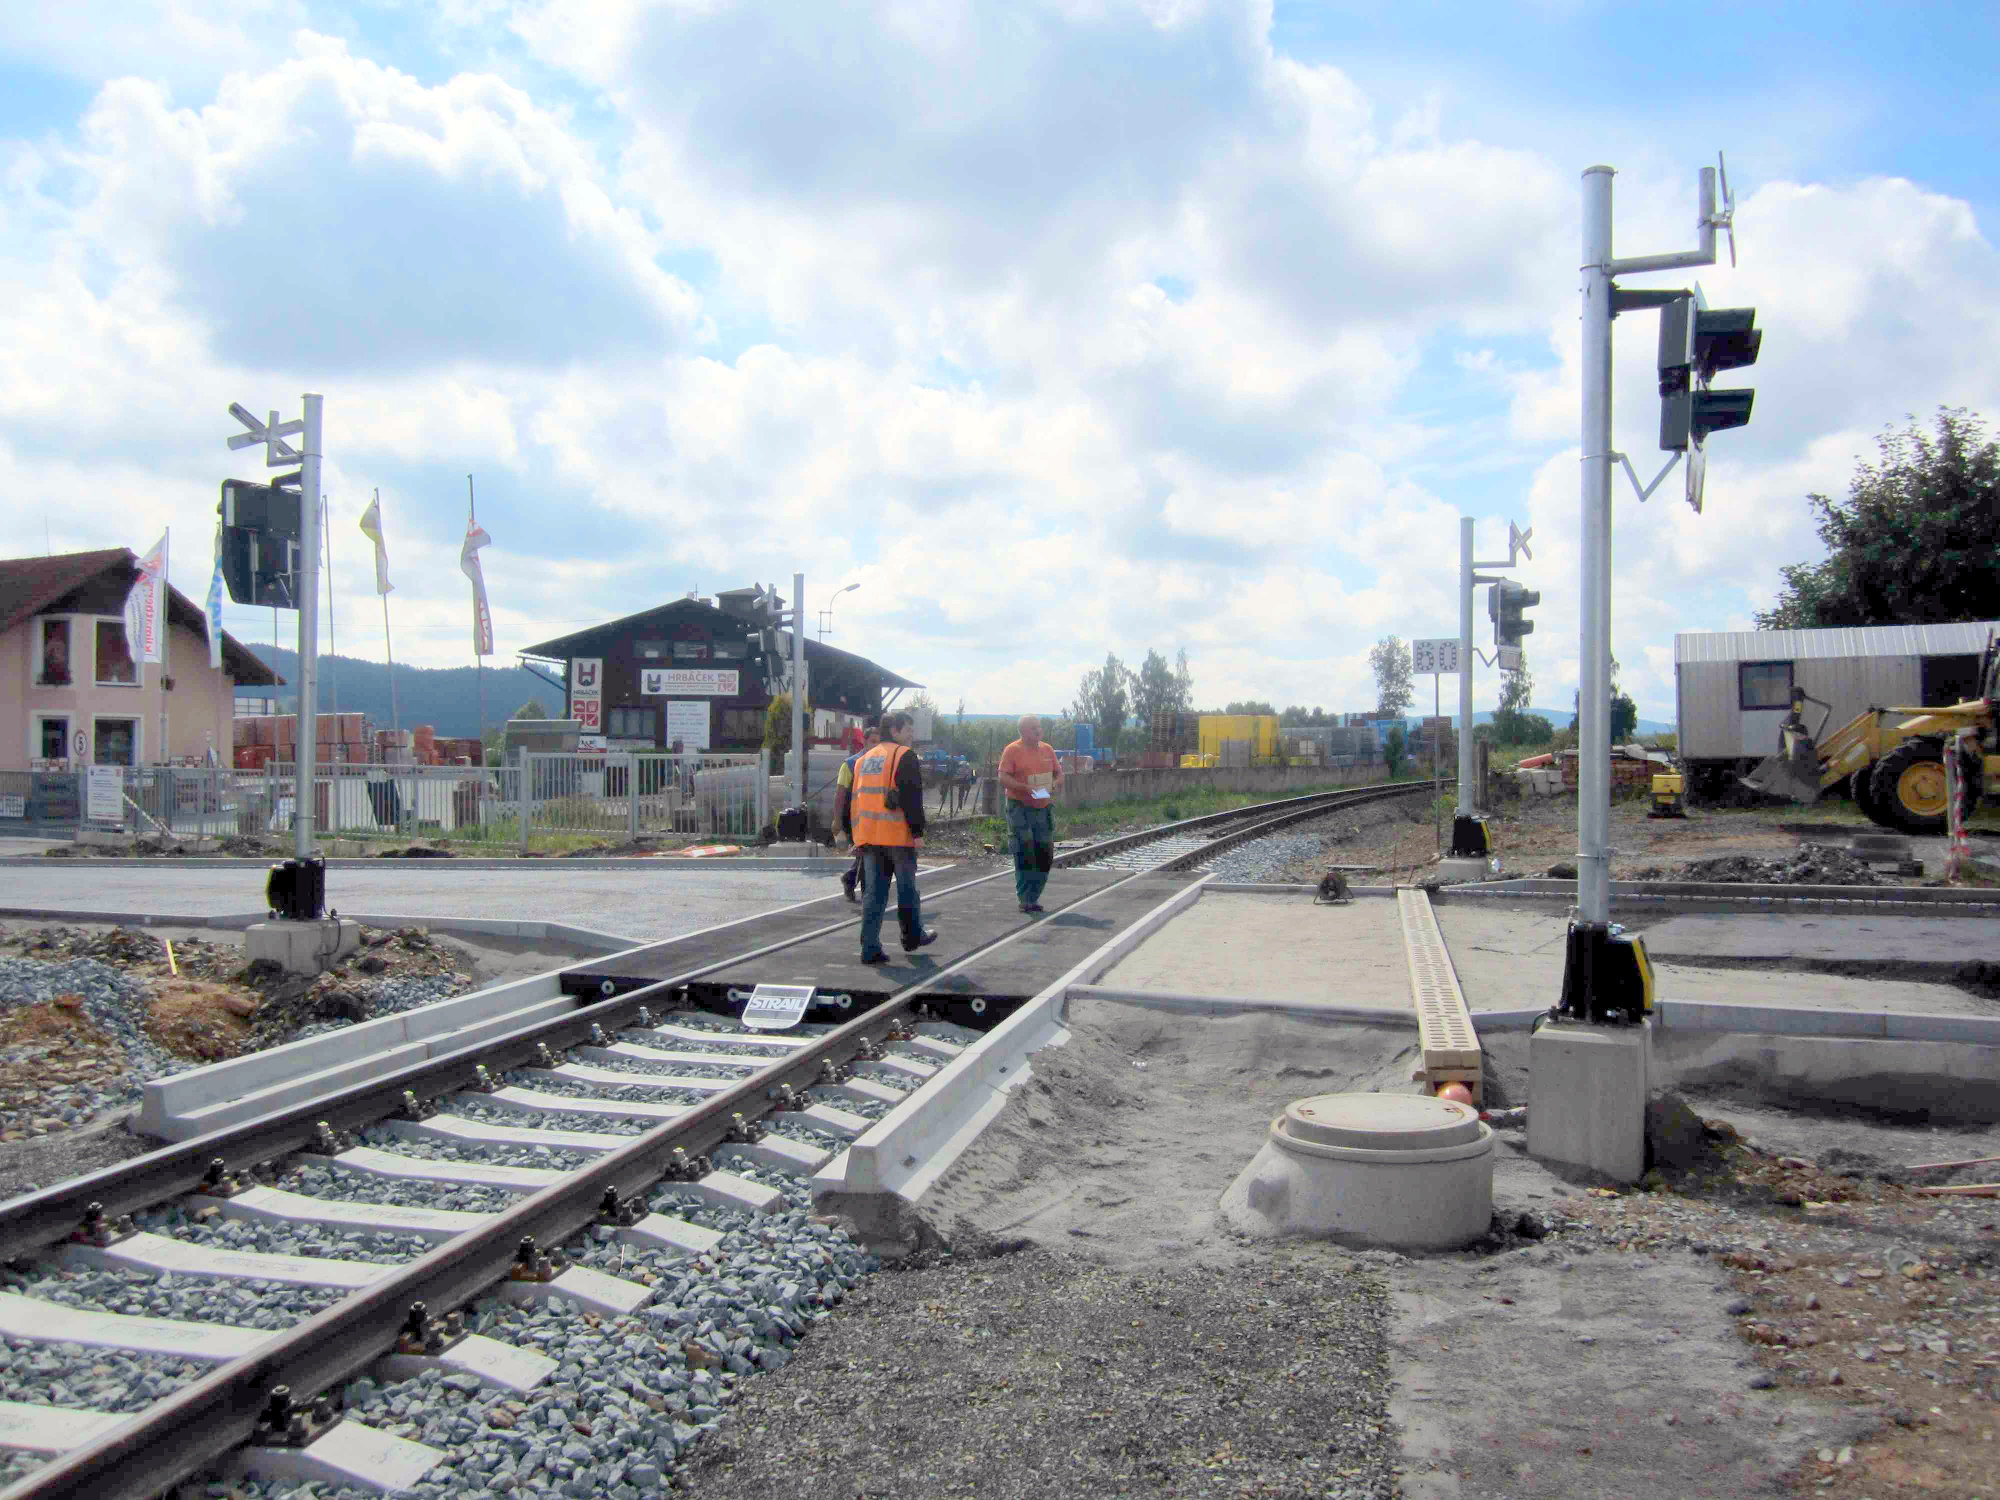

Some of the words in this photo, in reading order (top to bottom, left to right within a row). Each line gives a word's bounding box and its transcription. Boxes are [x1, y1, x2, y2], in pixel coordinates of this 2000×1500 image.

[1417, 641, 1457, 671] 60
[667, 670, 714, 682] HRBÁČEK
[750, 995, 804, 1010] STRAIL
